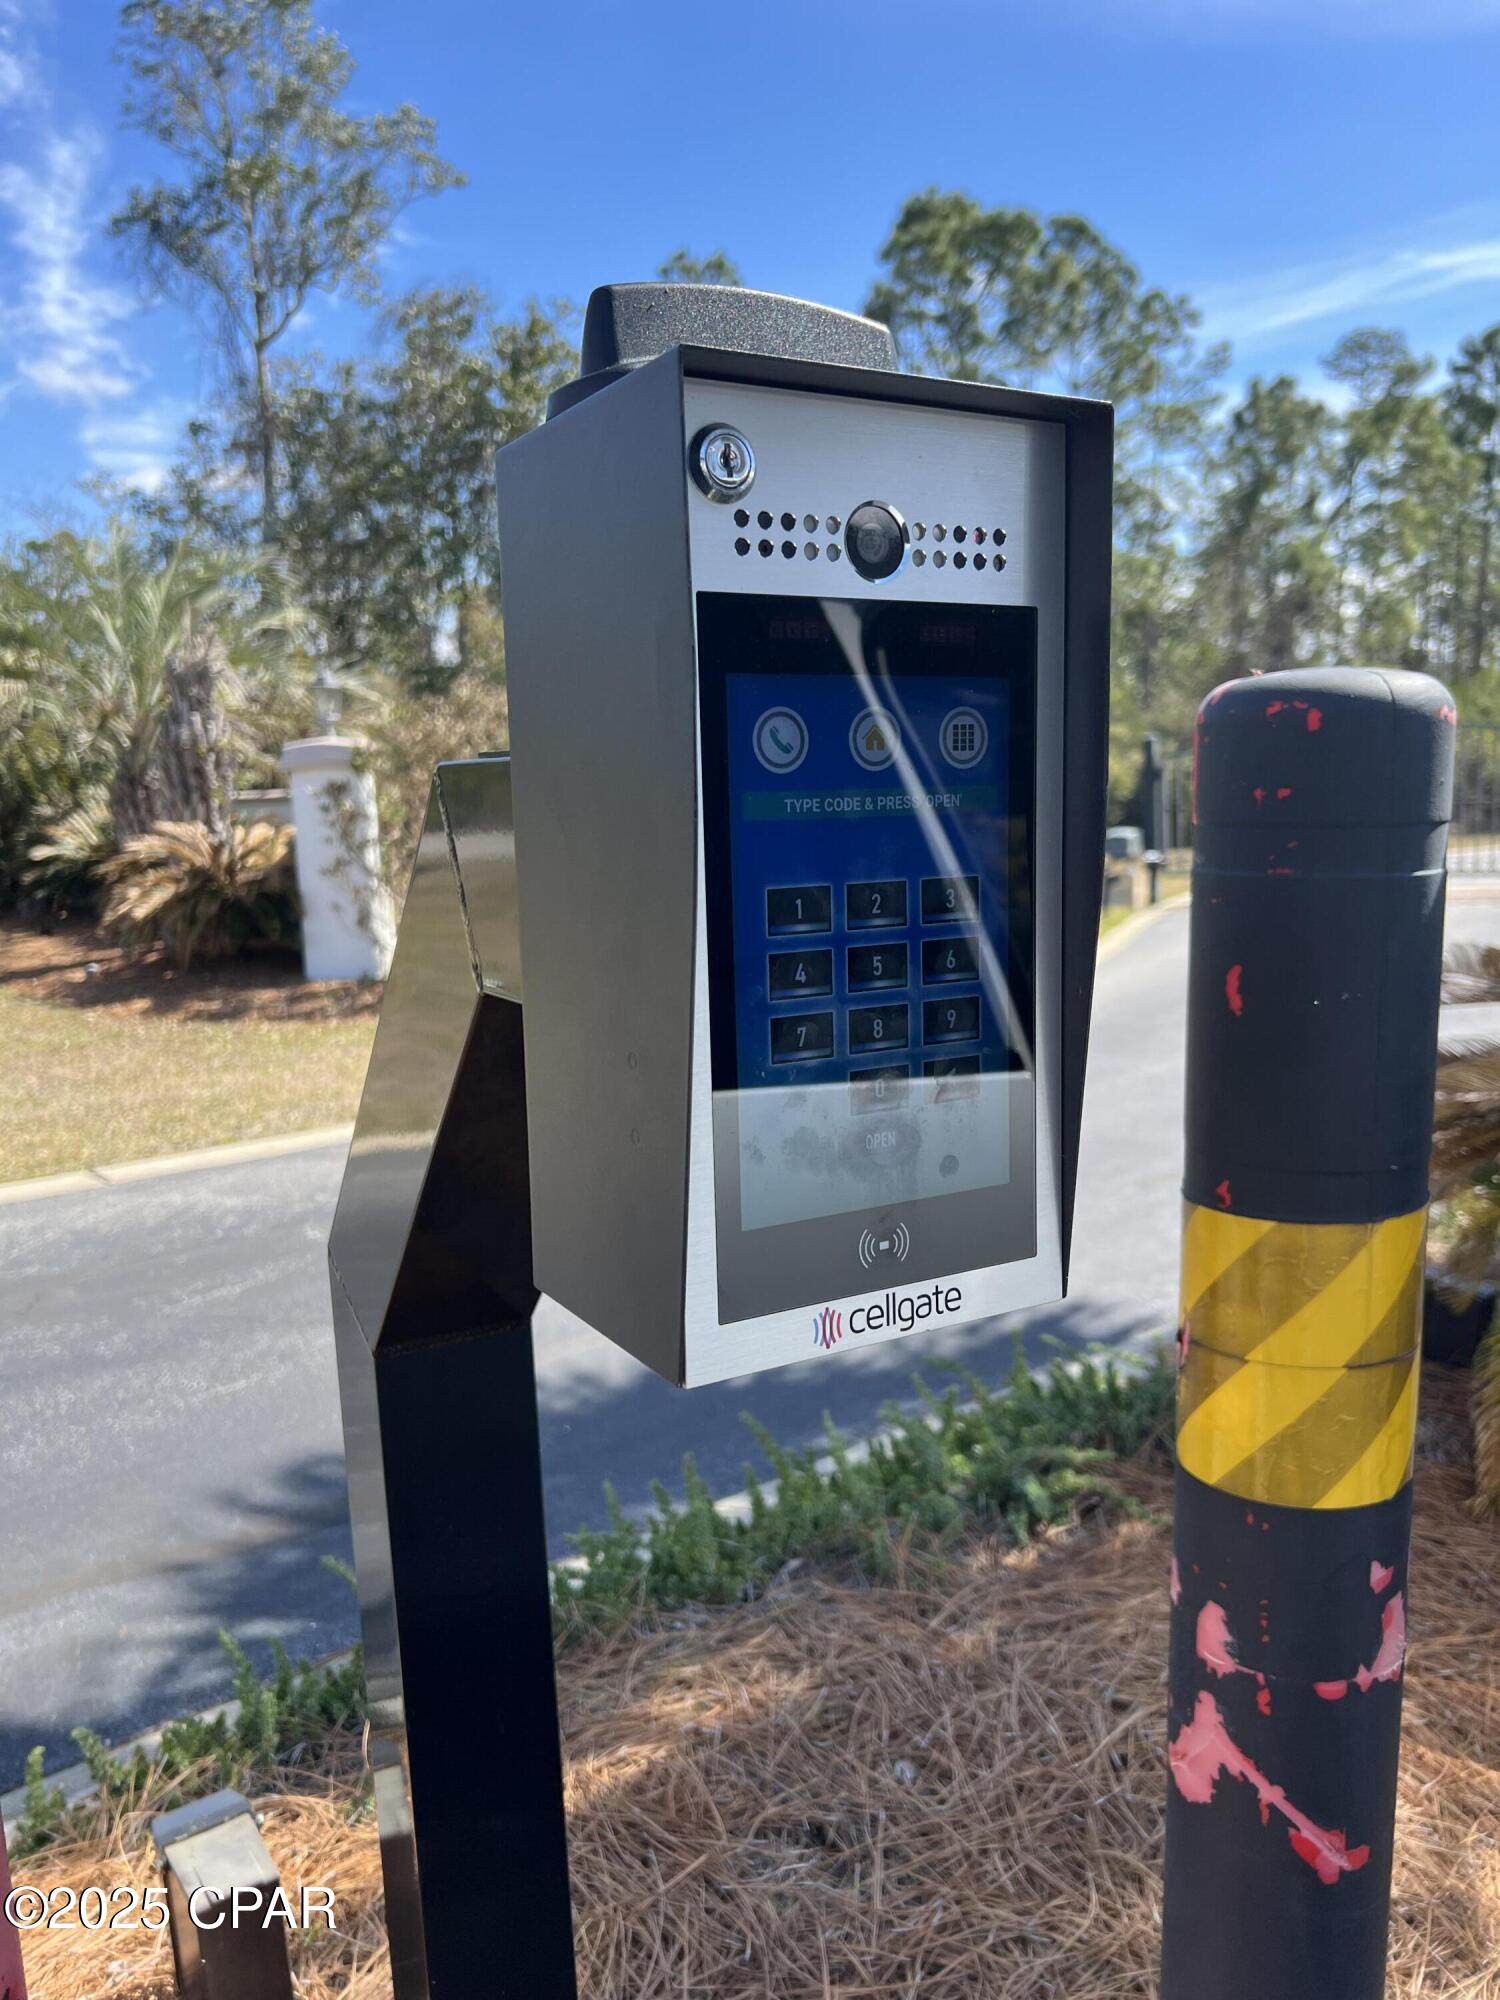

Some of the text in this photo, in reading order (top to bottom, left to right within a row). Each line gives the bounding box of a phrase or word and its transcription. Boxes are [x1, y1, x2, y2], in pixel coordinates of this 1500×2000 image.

[784, 798, 821, 813] TYPE
[824, 797, 862, 812] CODE
[864, 797, 874, 810] &
[877, 795, 919, 810] PRESS
[794, 898, 803, 919] 1
[871, 893, 881, 914] 2
[945, 889, 955, 908] 3
[872, 956, 882, 976] 5
[946, 950, 956, 969] 6
[795, 962, 807, 984] 4
[872, 1019, 884, 1038] 8
[947, 1009, 957, 1029] 9
[796, 1026, 806, 1047] 7
[875, 1078, 885, 1098] 0
[865, 1131, 896, 1150] OPEN
[849, 1284, 962, 1334] cellgate
